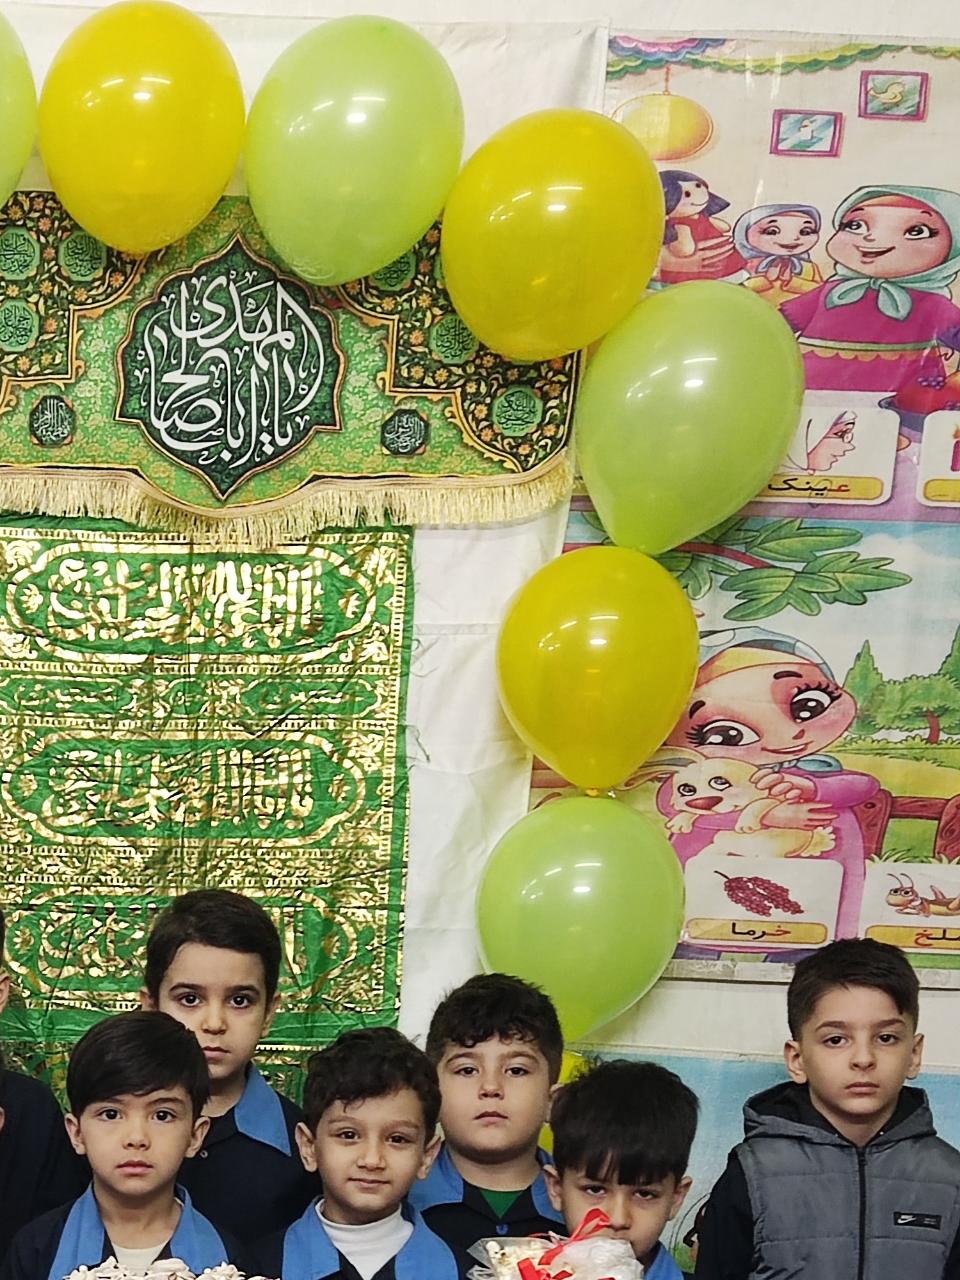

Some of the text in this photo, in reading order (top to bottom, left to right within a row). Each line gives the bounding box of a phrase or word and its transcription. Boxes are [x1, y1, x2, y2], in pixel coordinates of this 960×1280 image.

[768, 478, 850, 496] عینک
[732, 922, 792, 940] خرما
[914, 928, 960, 947] لخ
